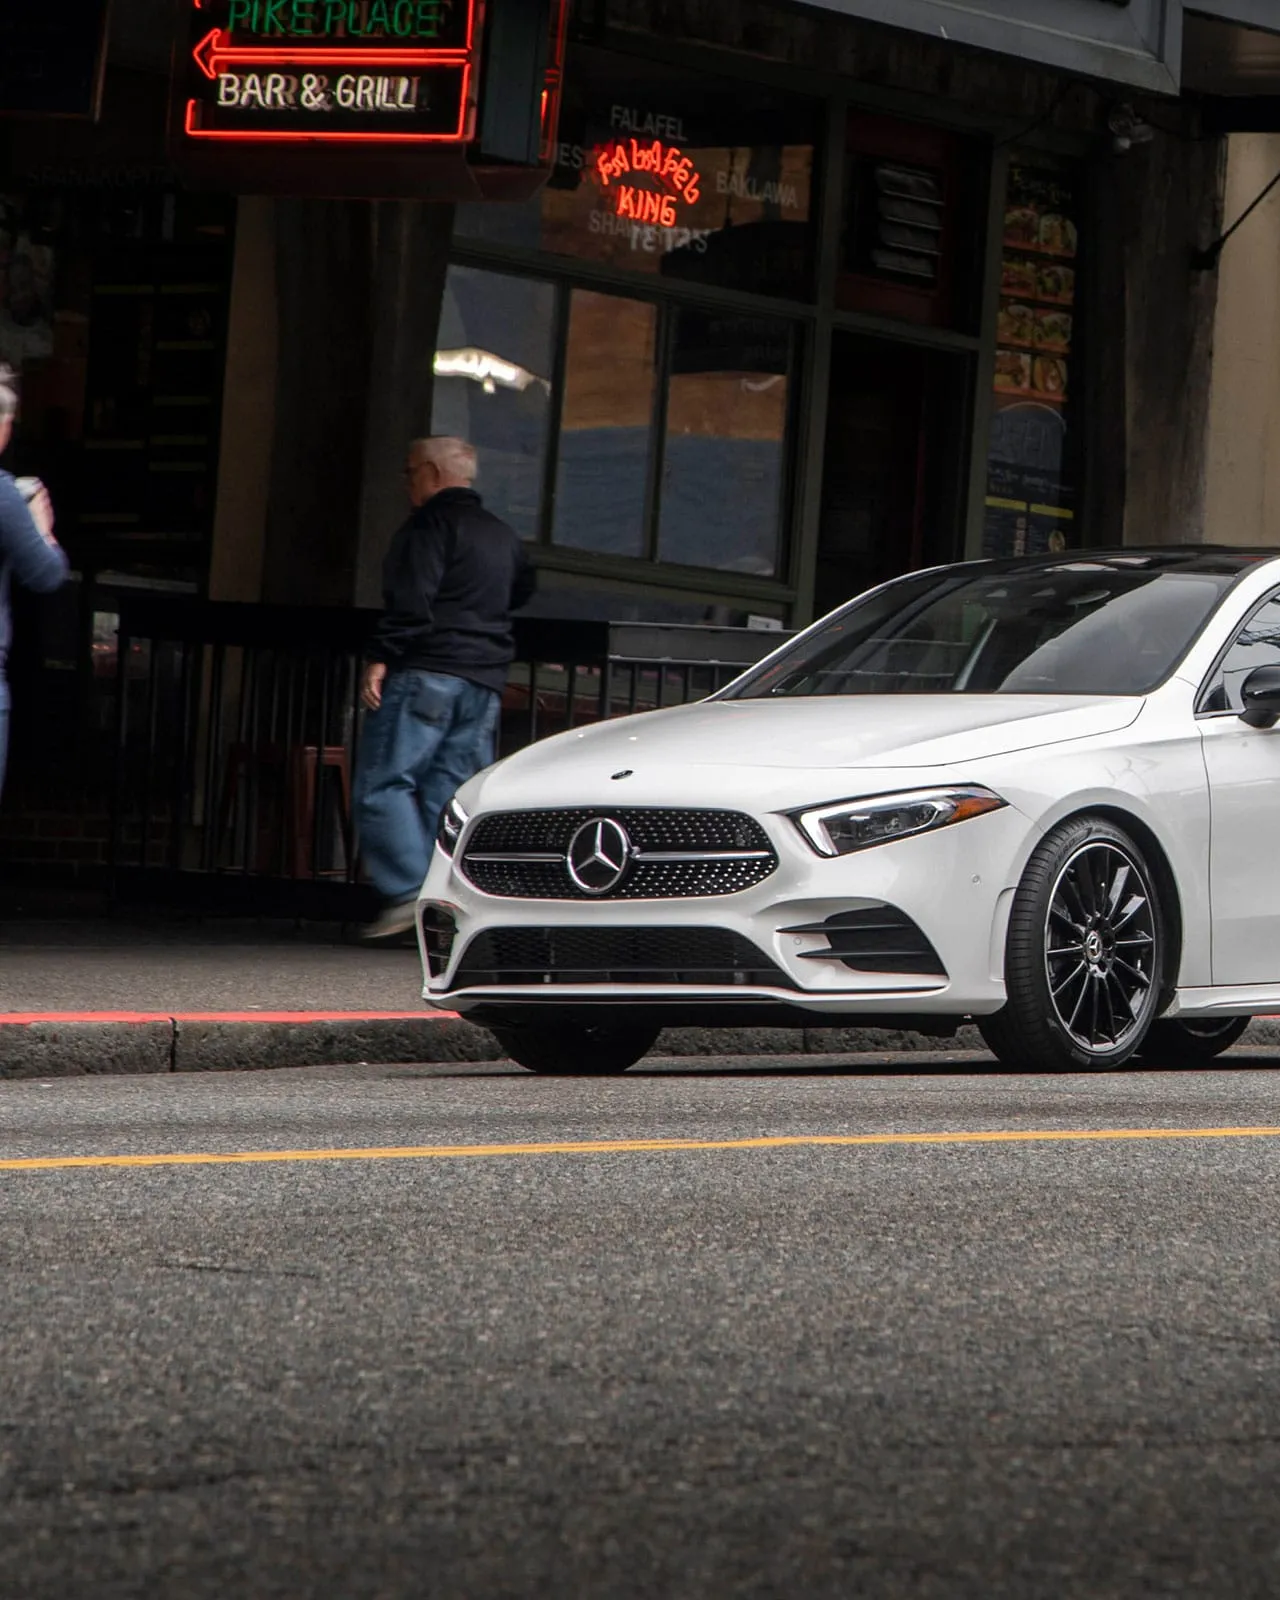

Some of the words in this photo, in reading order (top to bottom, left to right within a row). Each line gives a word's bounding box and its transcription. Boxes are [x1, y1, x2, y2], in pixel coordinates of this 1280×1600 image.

[229, 0, 313, 34] PIKE
[324, 0, 441, 36] PLACE
[217, 73, 286, 108] BAR
[300, 73, 325, 109] &
[334, 74, 417, 109] GRILL
[610, 104, 688, 142] FALAFEL
[616, 184, 678, 228] KING
[716, 171, 799, 209] BAKLAWA
